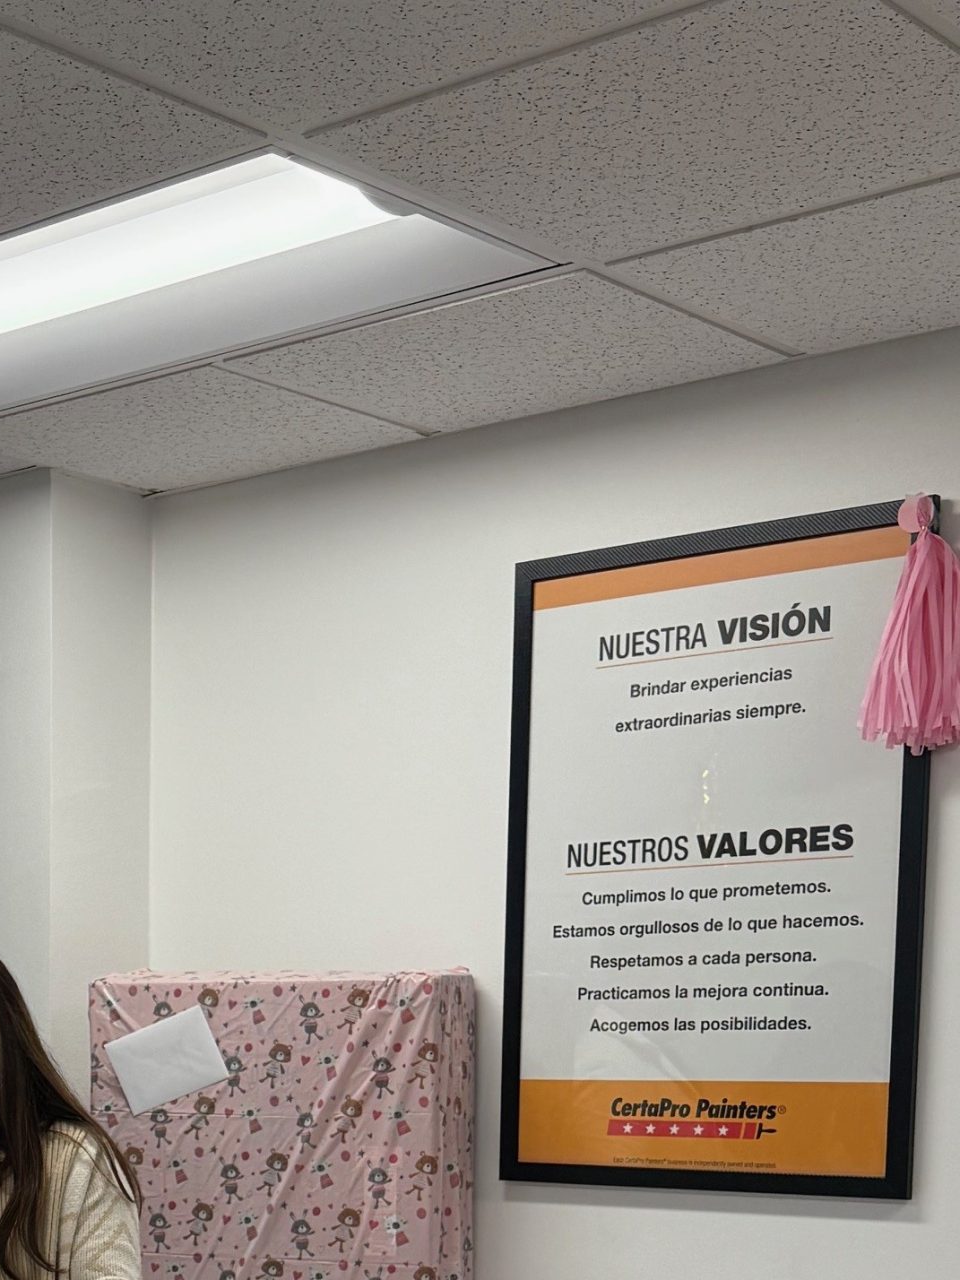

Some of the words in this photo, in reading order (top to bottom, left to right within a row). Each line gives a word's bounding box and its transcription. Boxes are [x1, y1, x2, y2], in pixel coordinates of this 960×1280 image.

[599, 622, 708, 662] NUESTRA
[717, 602, 833, 645] VISIÓN
[630, 679, 687, 698] Brindar
[690, 667, 793, 692] experiencias
[615, 708, 732, 733] extraordinarias
[735, 702, 806, 720] siempre.
[567, 835, 689, 869] NUESTROS
[696, 823, 854, 862] VALORES
[581, 889, 666, 907] Cumplimos
[670, 886, 685, 901] lo
[688, 887, 719, 903] que
[722, 881, 832, 902] prometemos.
[552, 924, 616, 939] Estamos
[619, 920, 700, 939] orgullosos
[703, 917, 724, 933] de
[728, 916, 743, 931] lo
[747, 918, 778, 934] que
[782, 914, 864, 929] hacemos.
[590, 954, 684, 971] Respetamos
[687, 954, 698, 966] a
[701, 950, 741, 966] cada
[745, 951, 817, 968] persona.
[577, 985, 671, 1001] Practicamos
[674, 984, 689, 999] la
[692, 983, 748, 1001] mejora
[752, 981, 829, 997] continua.
[589, 1018, 670, 1035] Acogemos
[673, 1017, 696, 1032] las
[700, 1015, 812, 1035] posibilidades.
[611, 1097, 690, 1118] CertaPro
